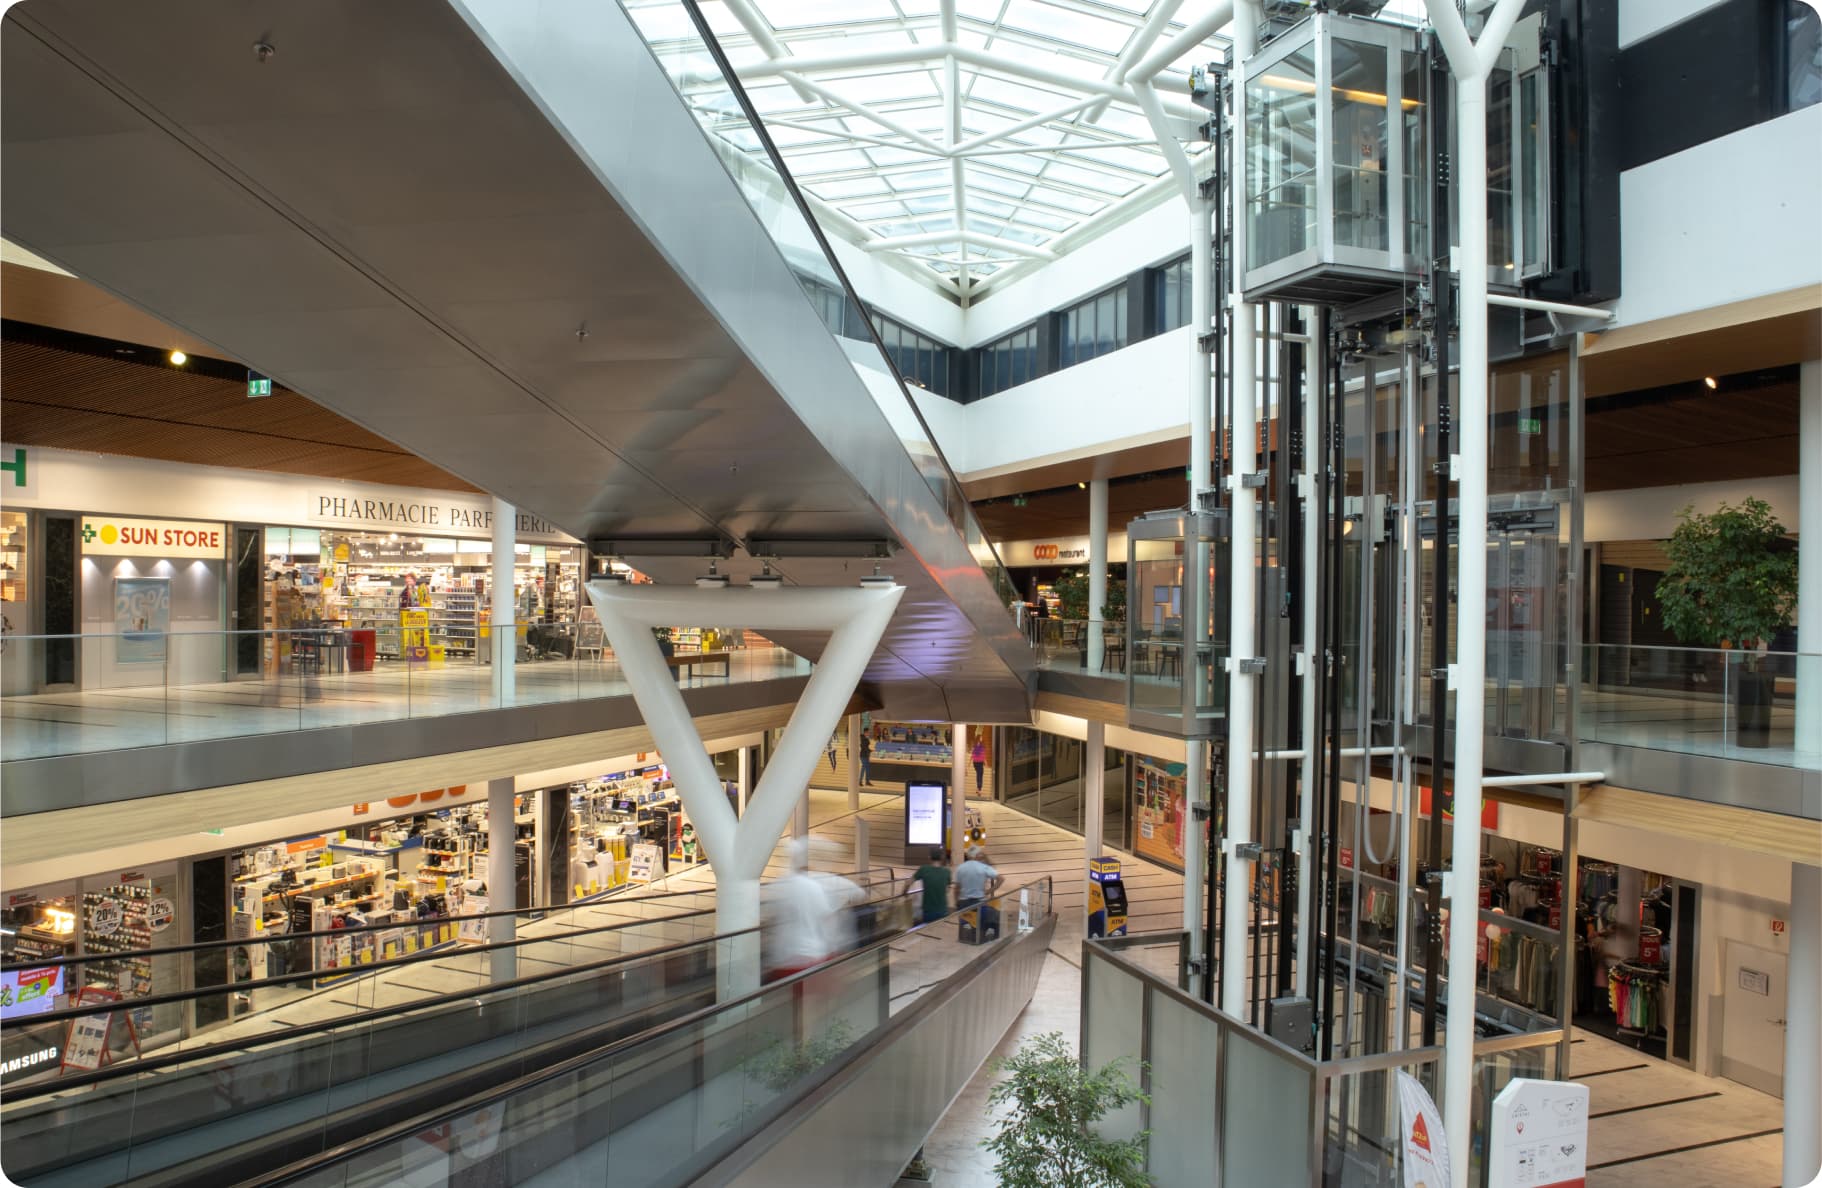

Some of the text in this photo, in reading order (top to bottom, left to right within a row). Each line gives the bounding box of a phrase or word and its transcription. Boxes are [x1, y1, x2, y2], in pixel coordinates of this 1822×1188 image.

[319, 496, 556, 534] PHARMACIE PARFERI
[120, 527, 219, 548] SUN STORE
[117, 586, 169, 619] 20%
[96, 907, 118, 922] 20%
[150, 903, 169, 916] 12%
[0, 1046, 57, 1075] AMSUNG
